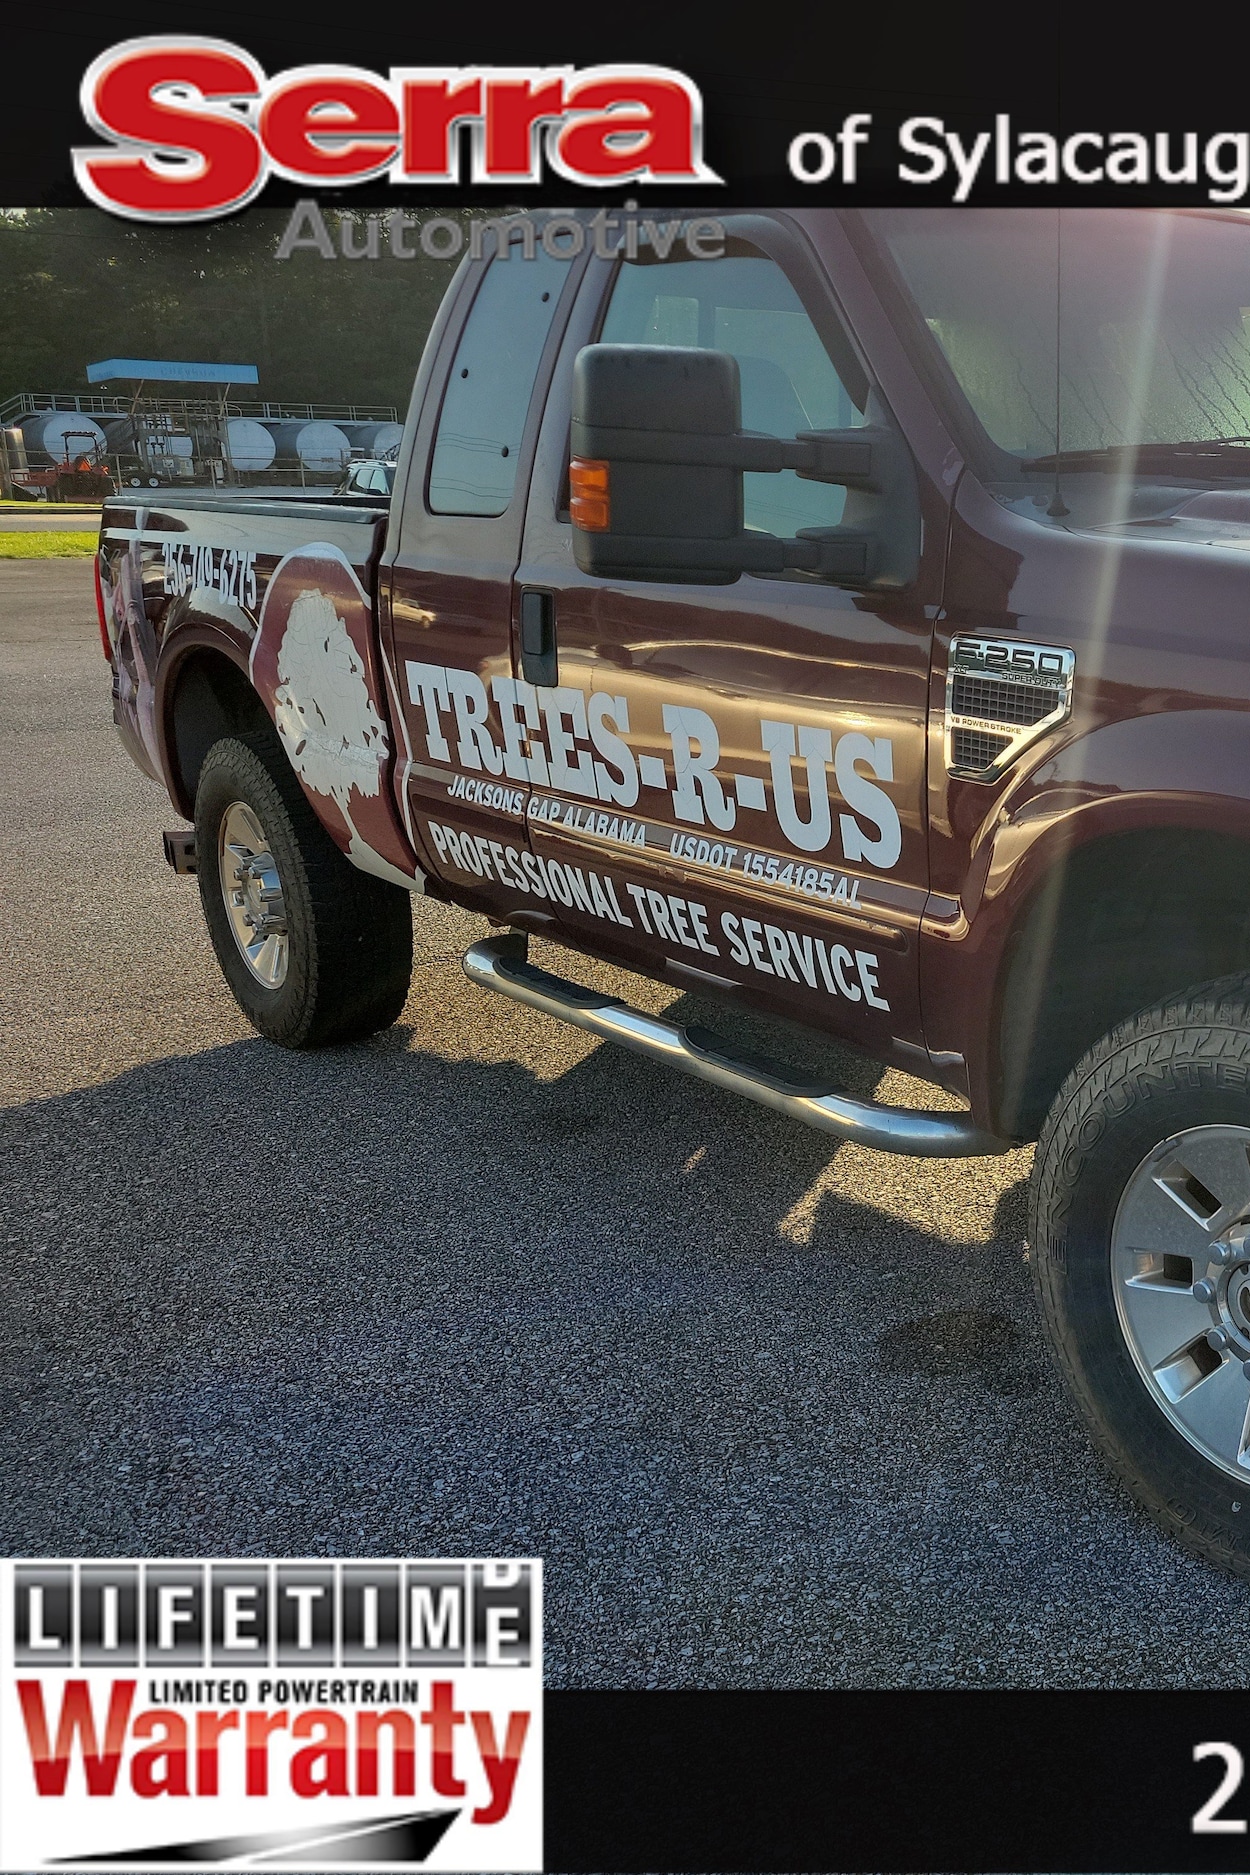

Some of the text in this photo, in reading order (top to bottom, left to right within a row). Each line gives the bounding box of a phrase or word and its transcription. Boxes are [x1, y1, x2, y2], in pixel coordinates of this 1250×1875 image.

[953, 641, 1065, 678] F-250
[404, 660, 903, 869] TREES-R-US
[446, 774, 863, 911] JACKSONS GAP ALABAMA USDOT 1554185AL
[427, 820, 892, 1012] PROFESSIONAL TREE SERVICE
